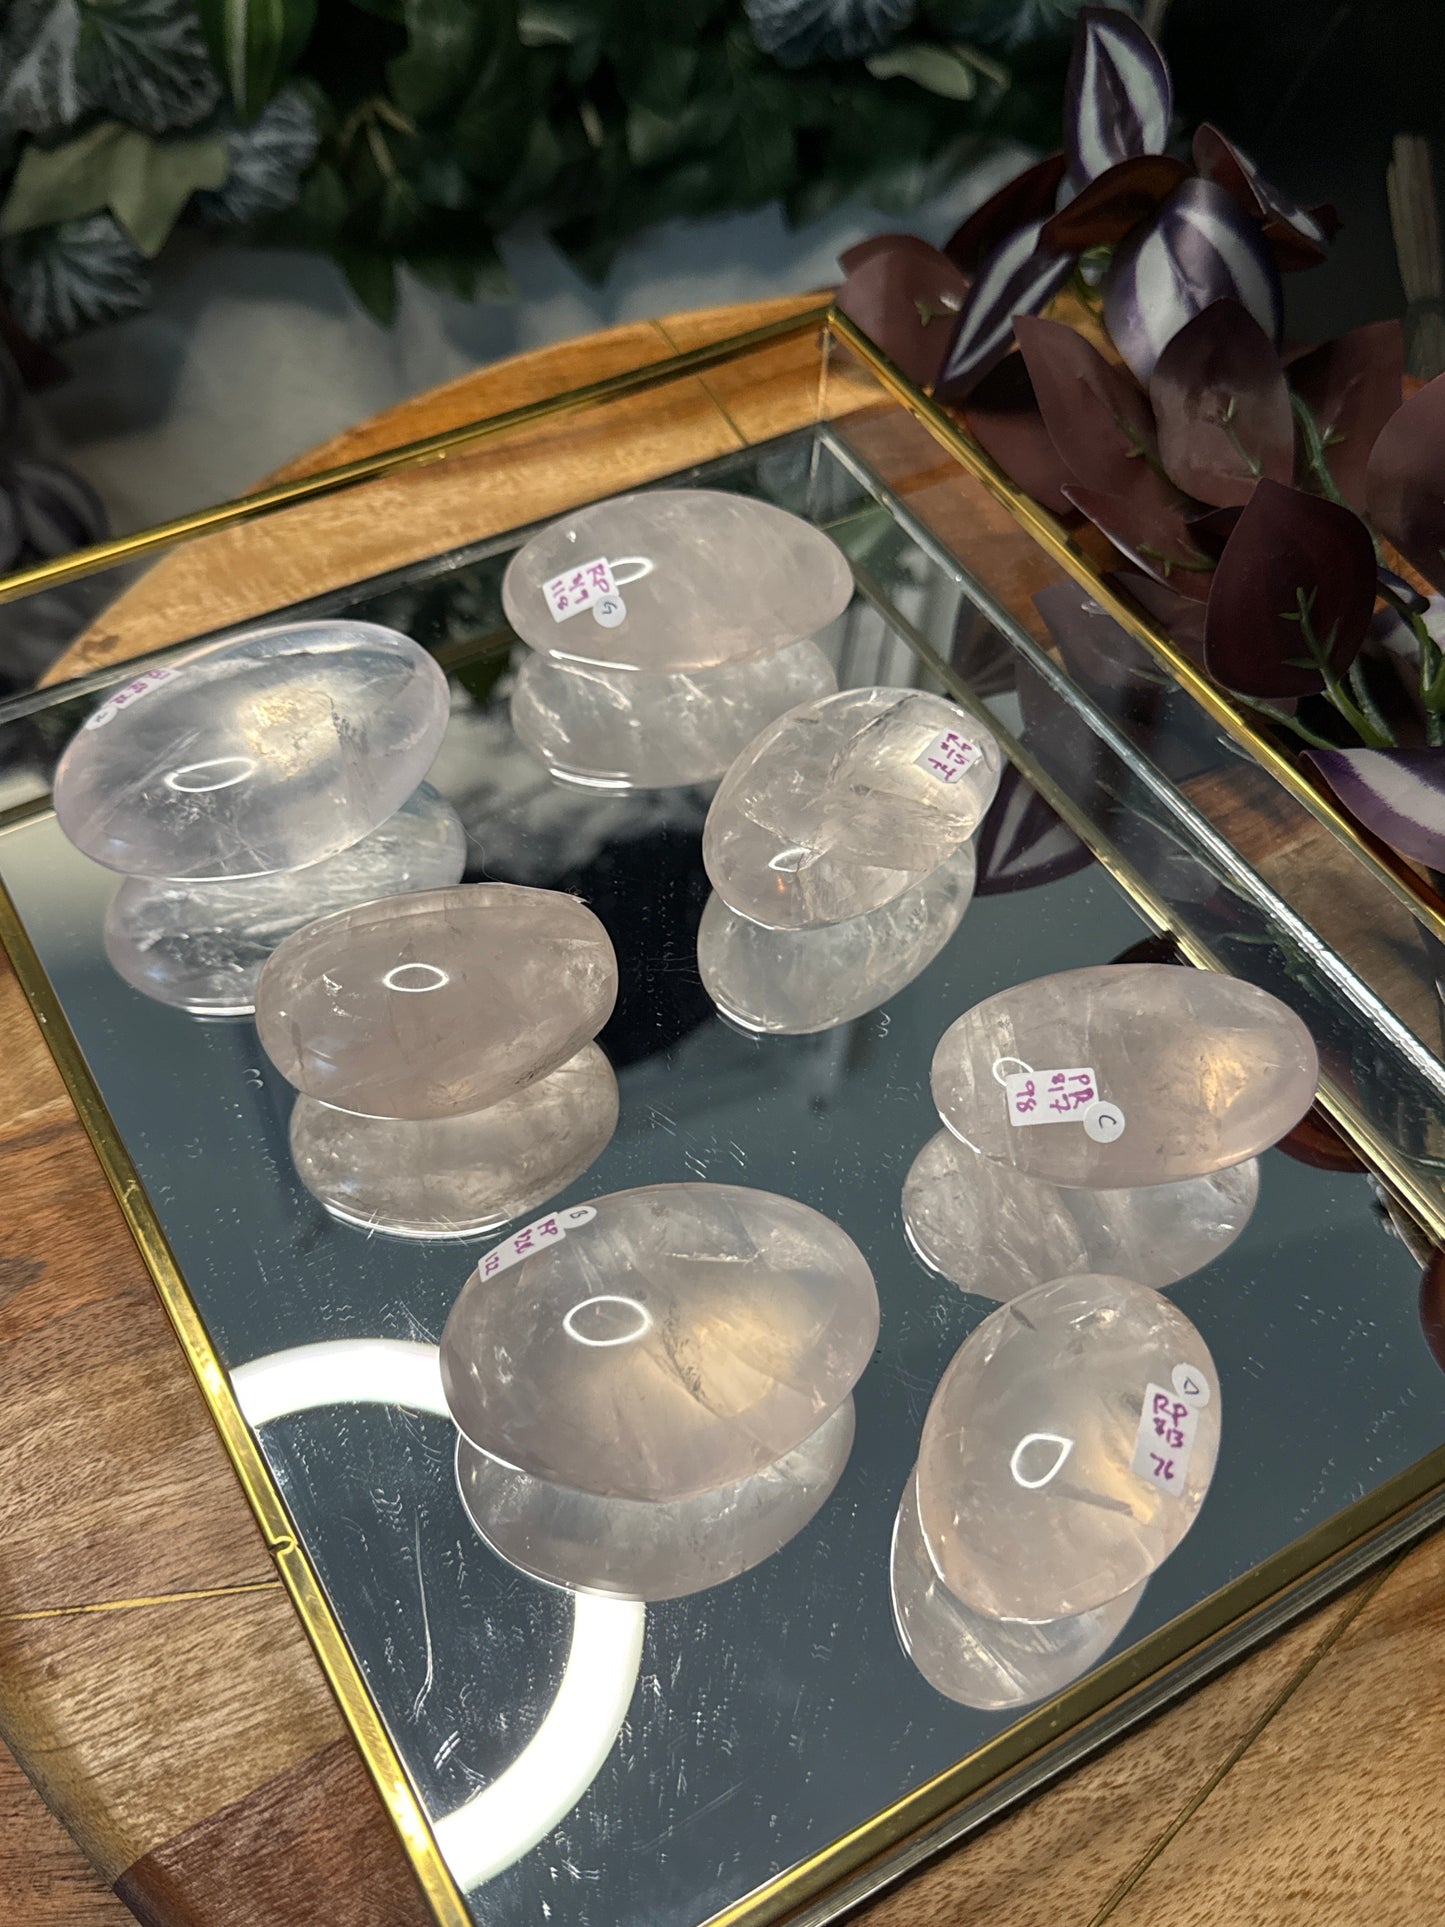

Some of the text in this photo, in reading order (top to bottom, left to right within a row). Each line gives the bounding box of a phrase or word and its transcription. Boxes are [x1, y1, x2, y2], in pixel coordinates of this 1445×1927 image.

[586, 563, 610, 593] RP
[551, 580, 569, 611] 118
[1016, 1080, 1037, 1113] 98
[1068, 1073, 1095, 1110] PR
[1098, 1114, 1118, 1129] C
[485, 1251, 500, 1276] 122
[1183, 1377, 1200, 1395] D
[1153, 1393, 1189, 1428] RP
[1149, 1452, 1175, 1480] 76
